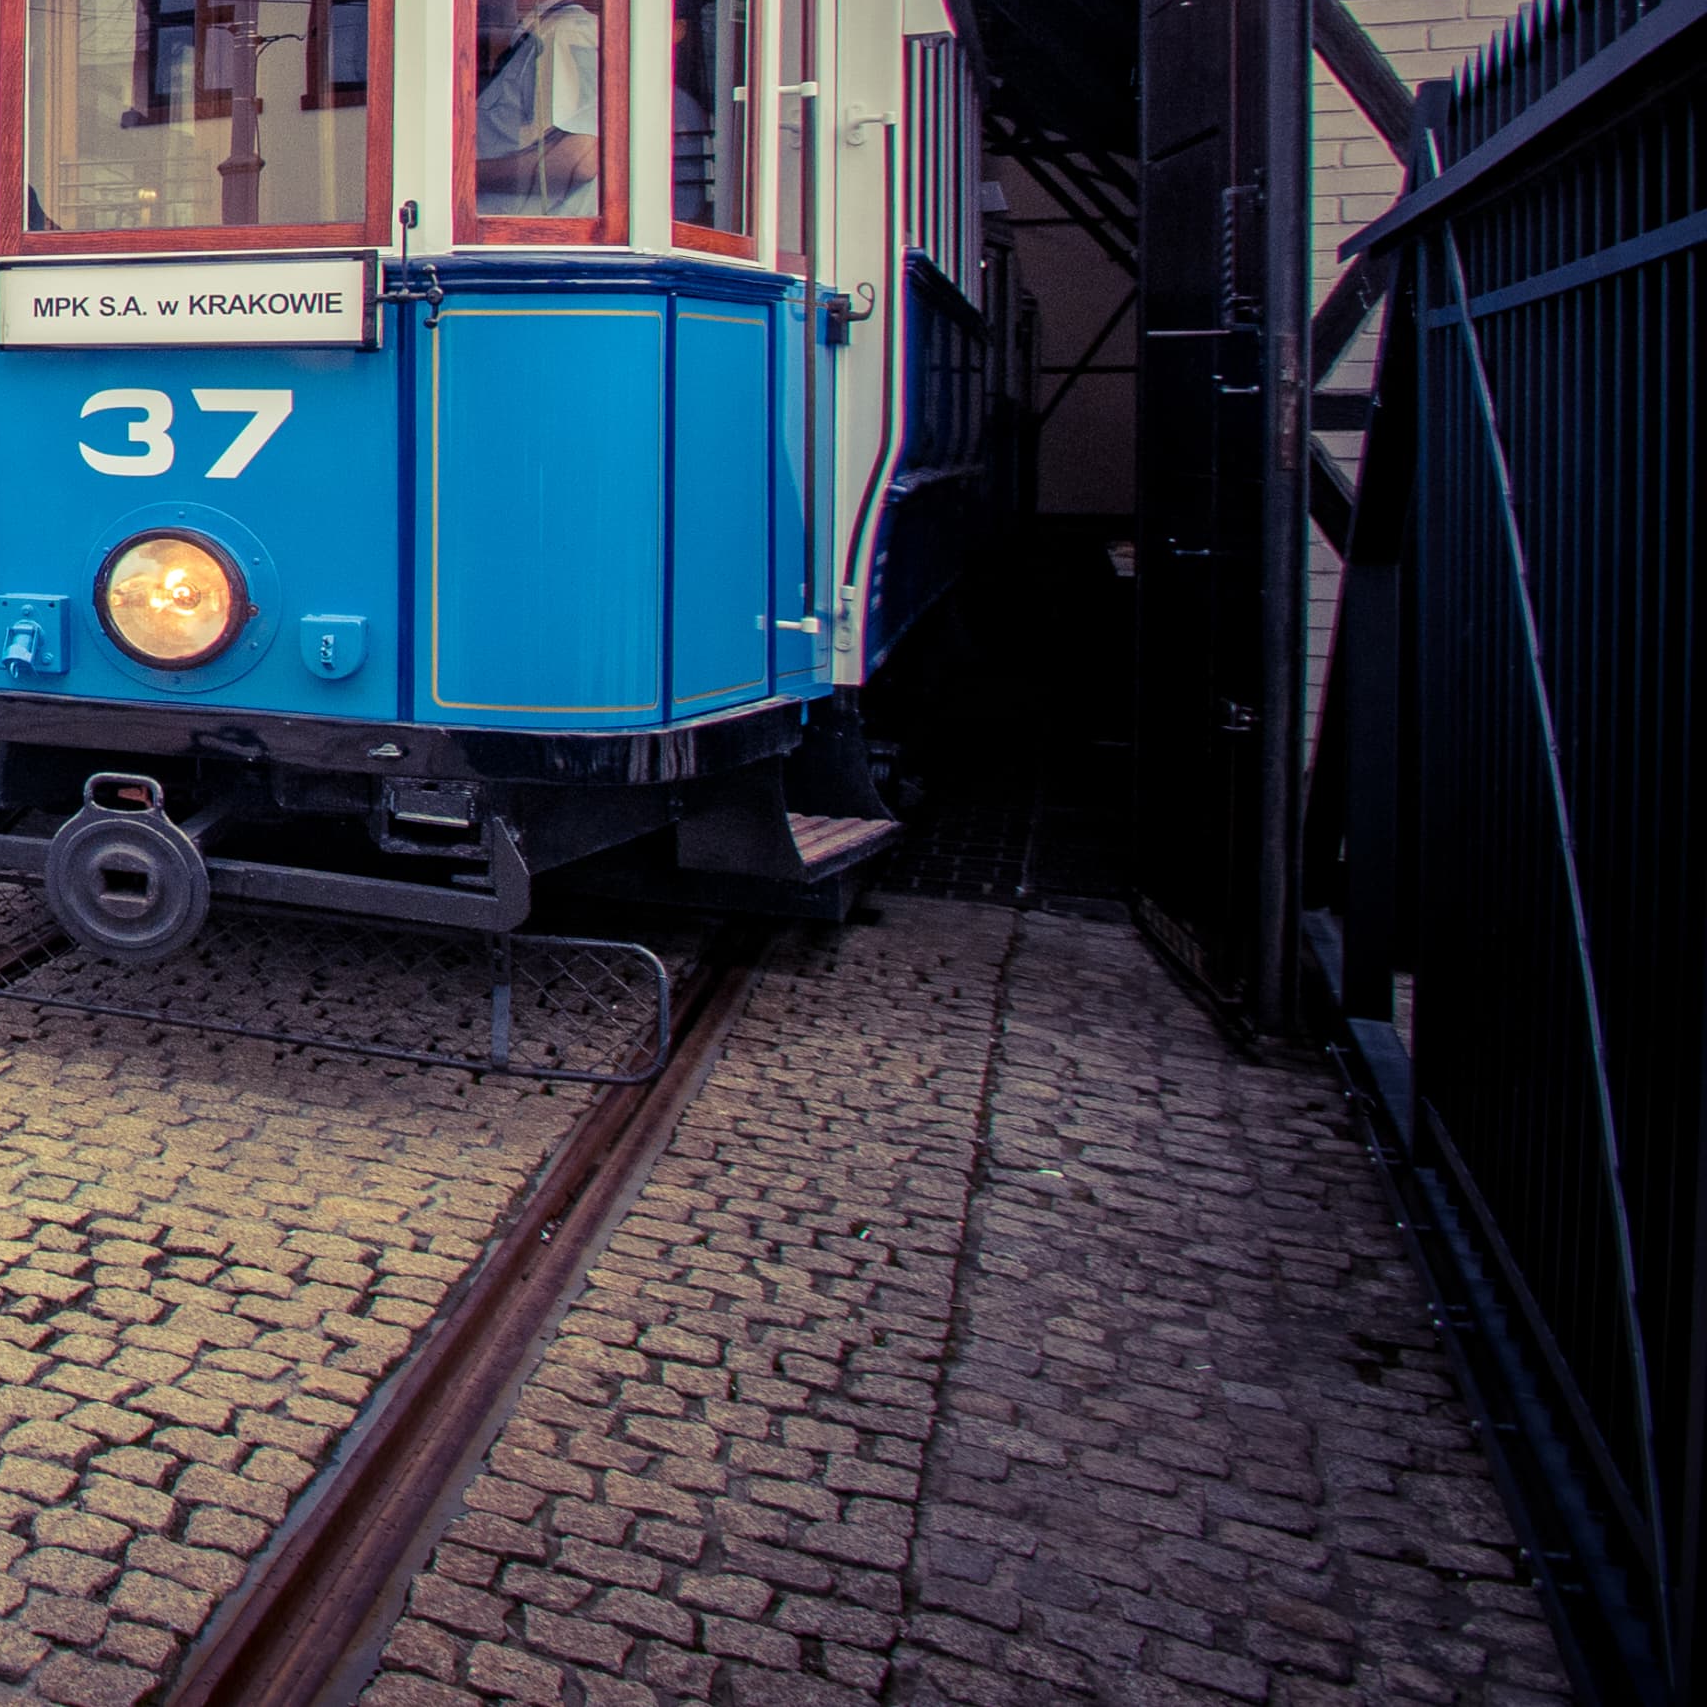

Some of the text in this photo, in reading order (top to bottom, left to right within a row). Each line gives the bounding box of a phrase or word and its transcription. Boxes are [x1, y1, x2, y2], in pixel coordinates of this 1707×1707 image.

[33, 292, 343, 318] MPK S.A. w KRAKOWIE
[78, 388, 293, 479] 37
